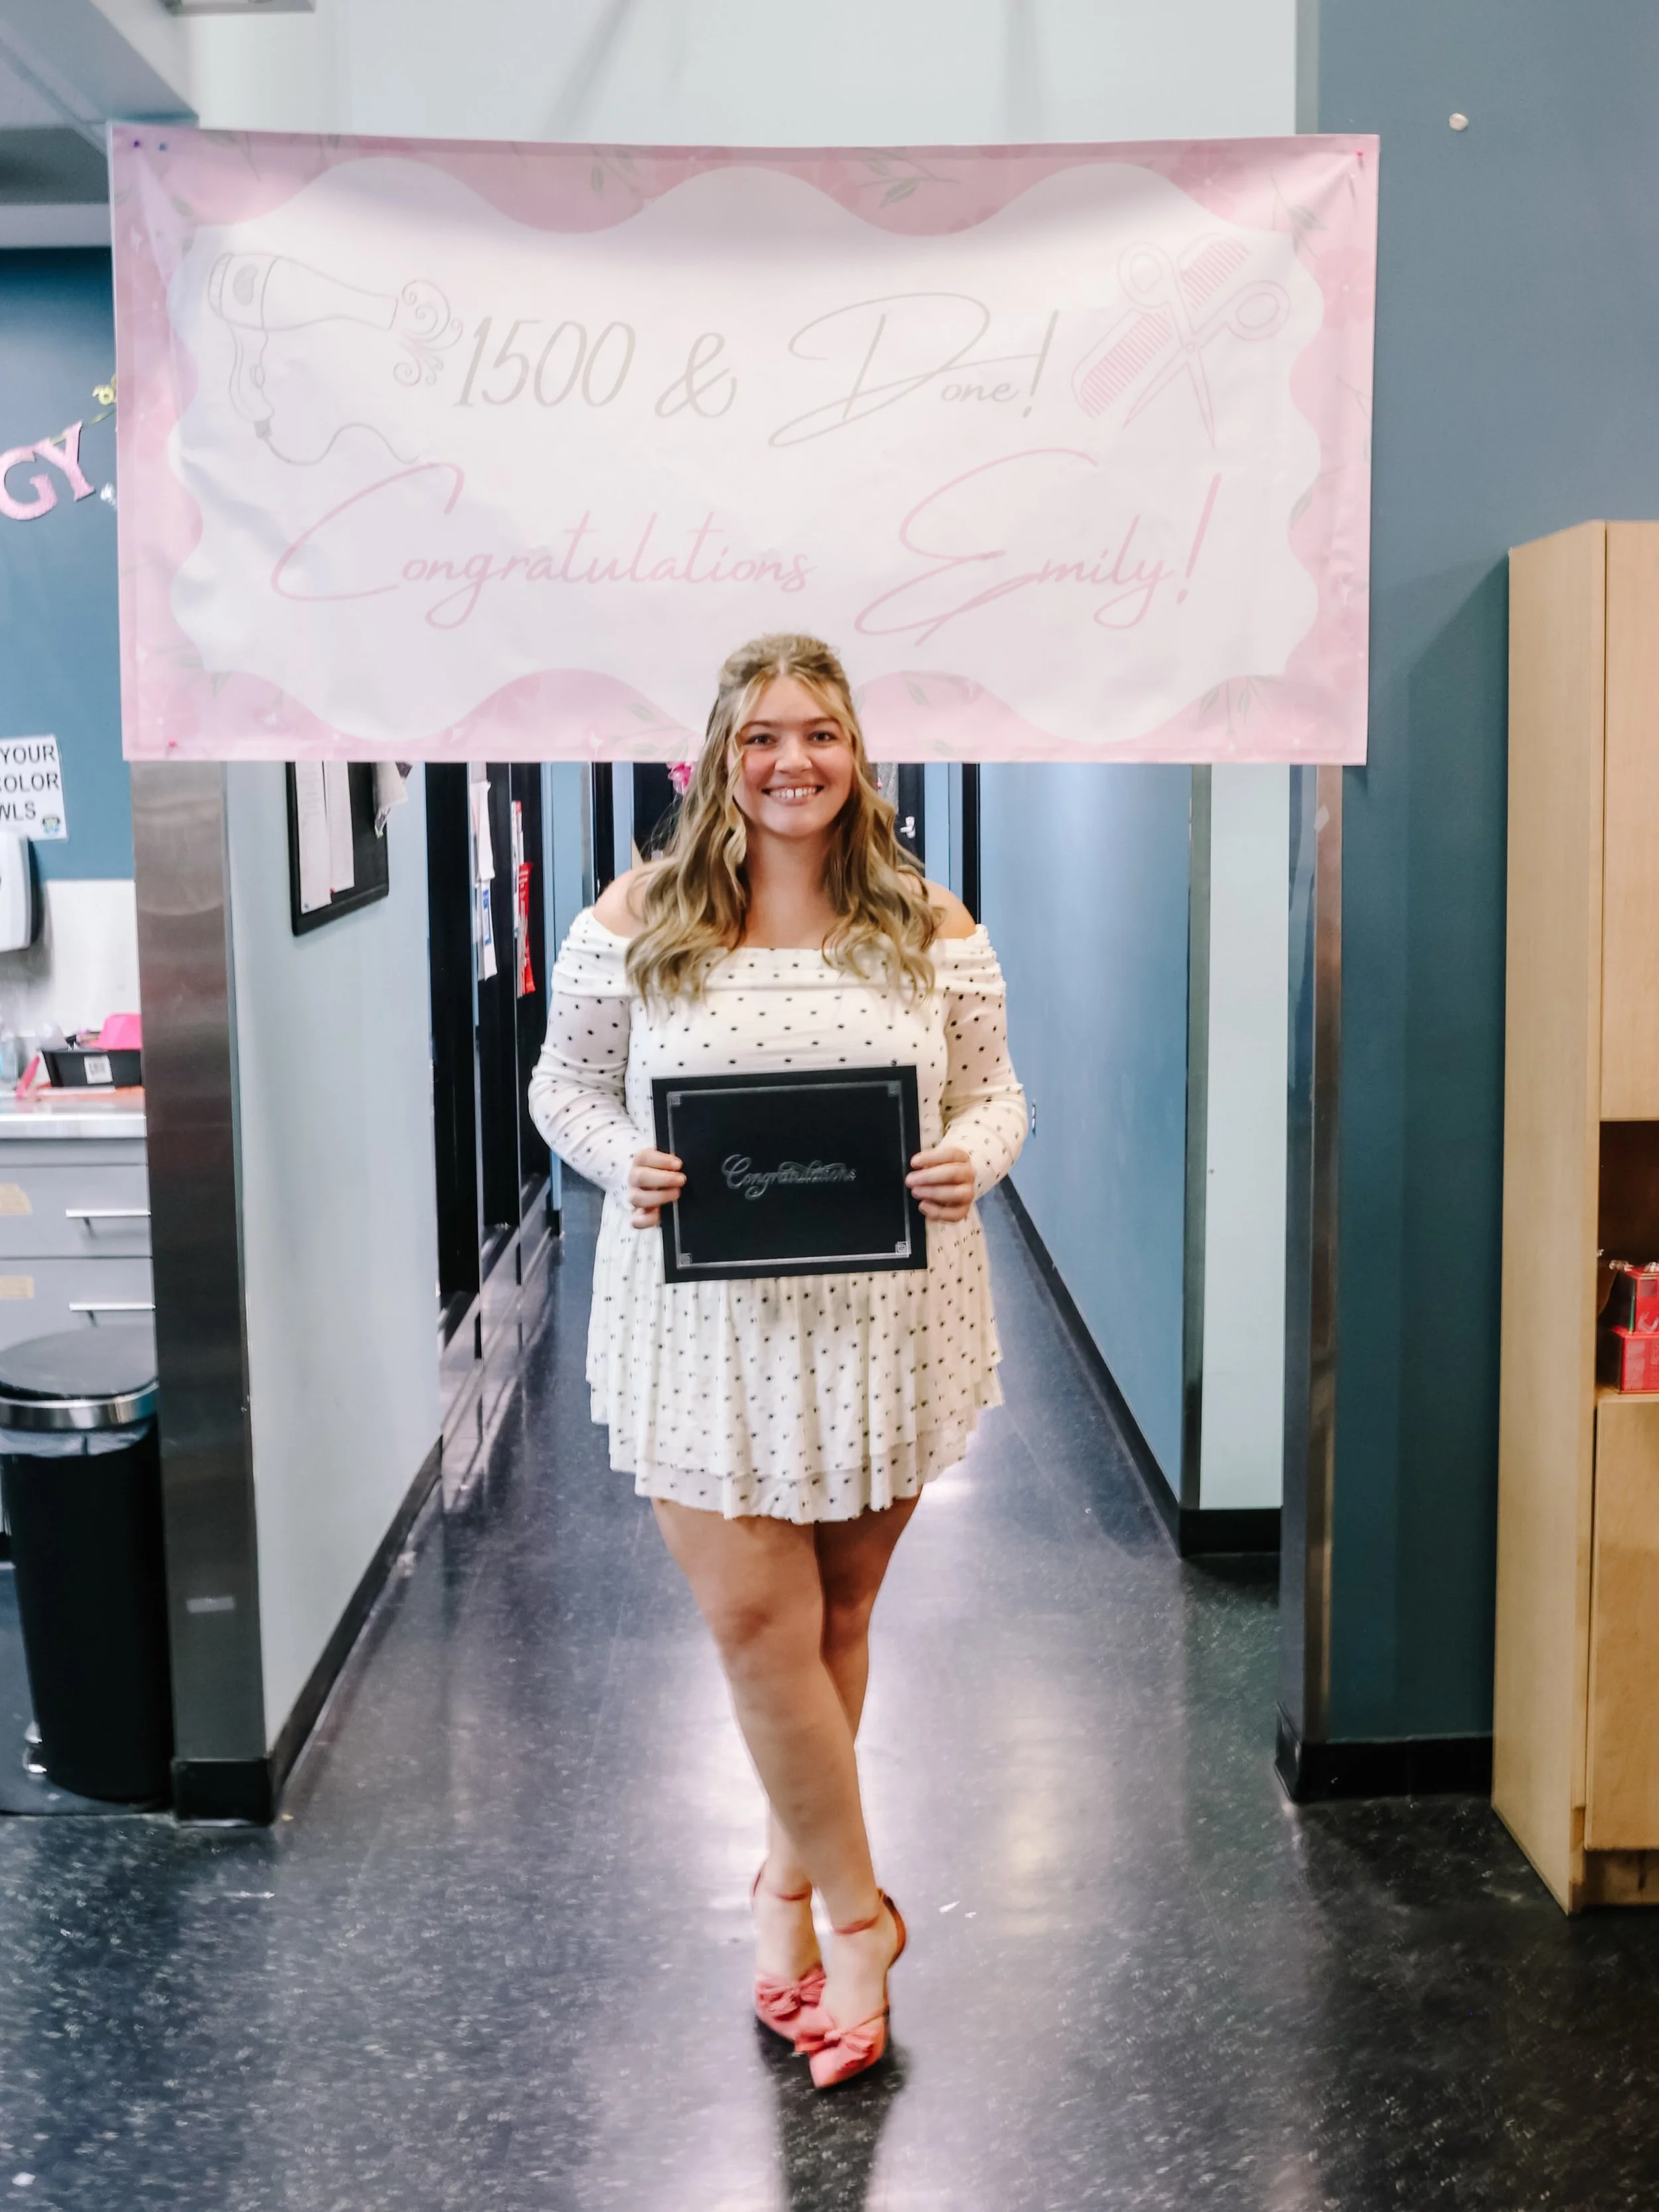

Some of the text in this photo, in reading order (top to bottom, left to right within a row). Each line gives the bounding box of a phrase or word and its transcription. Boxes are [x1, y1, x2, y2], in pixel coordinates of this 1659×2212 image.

[452, 292, 1058, 447] 1500 & Done!
[0, 420, 96, 520] GY
[270, 448, 1222, 646] Congratulations Emily!
[0, 743, 56, 765] YOUR
[0, 772, 60, 793] OLOR
[721, 1153, 857, 1200] Congratulations
